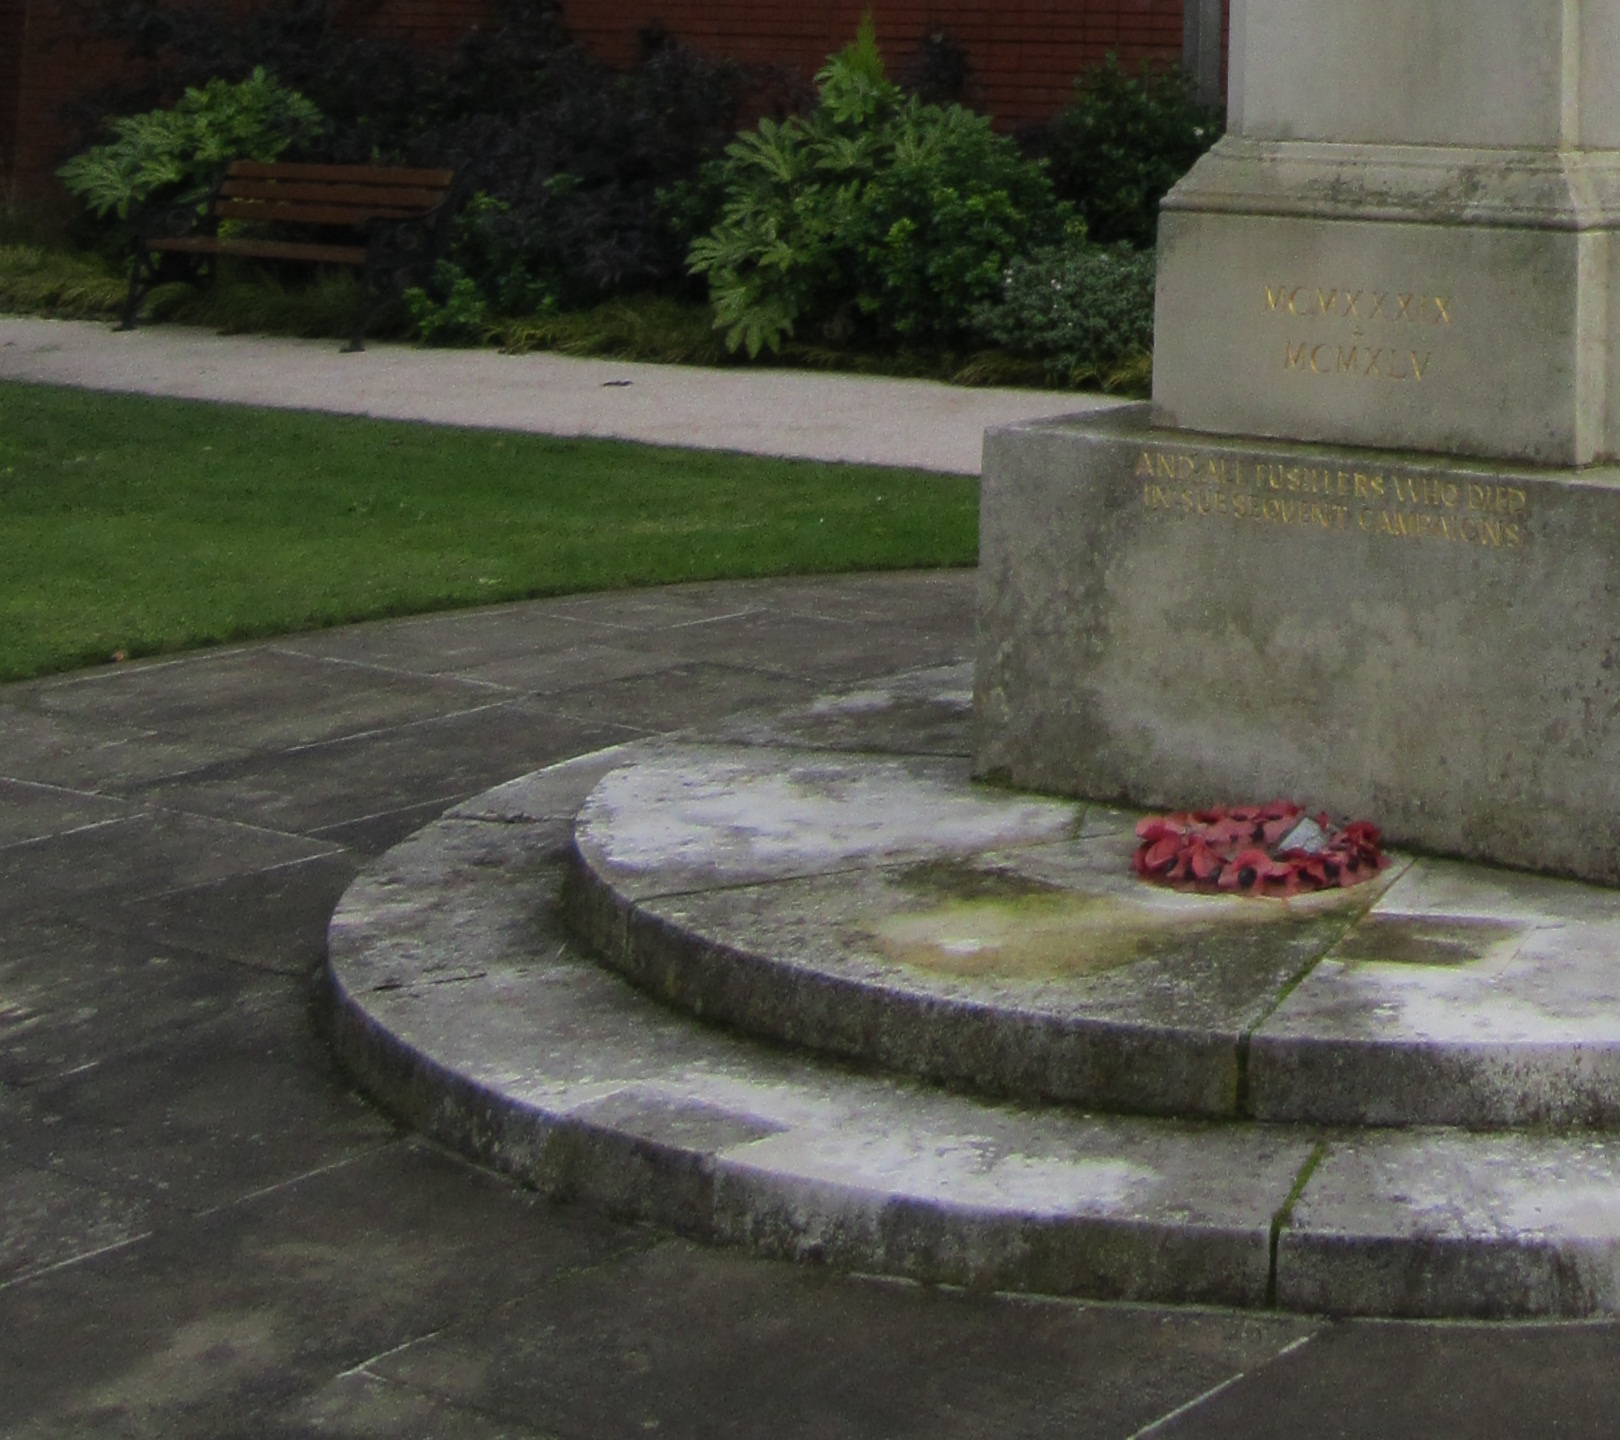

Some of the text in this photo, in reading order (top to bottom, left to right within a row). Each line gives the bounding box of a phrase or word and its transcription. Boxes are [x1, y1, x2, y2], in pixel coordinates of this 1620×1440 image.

[1262, 285, 1451, 326] MCMXXXIX
[1283, 339, 1432, 382] MCMXLV
[1135, 451, 1197, 481] AND
[1255, 463, 1385, 498] FUSILIERS
[1391, 475, 1458, 508] WHO
[1468, 482, 1527, 515] DIED
[1143, 483, 1172, 510] IN
